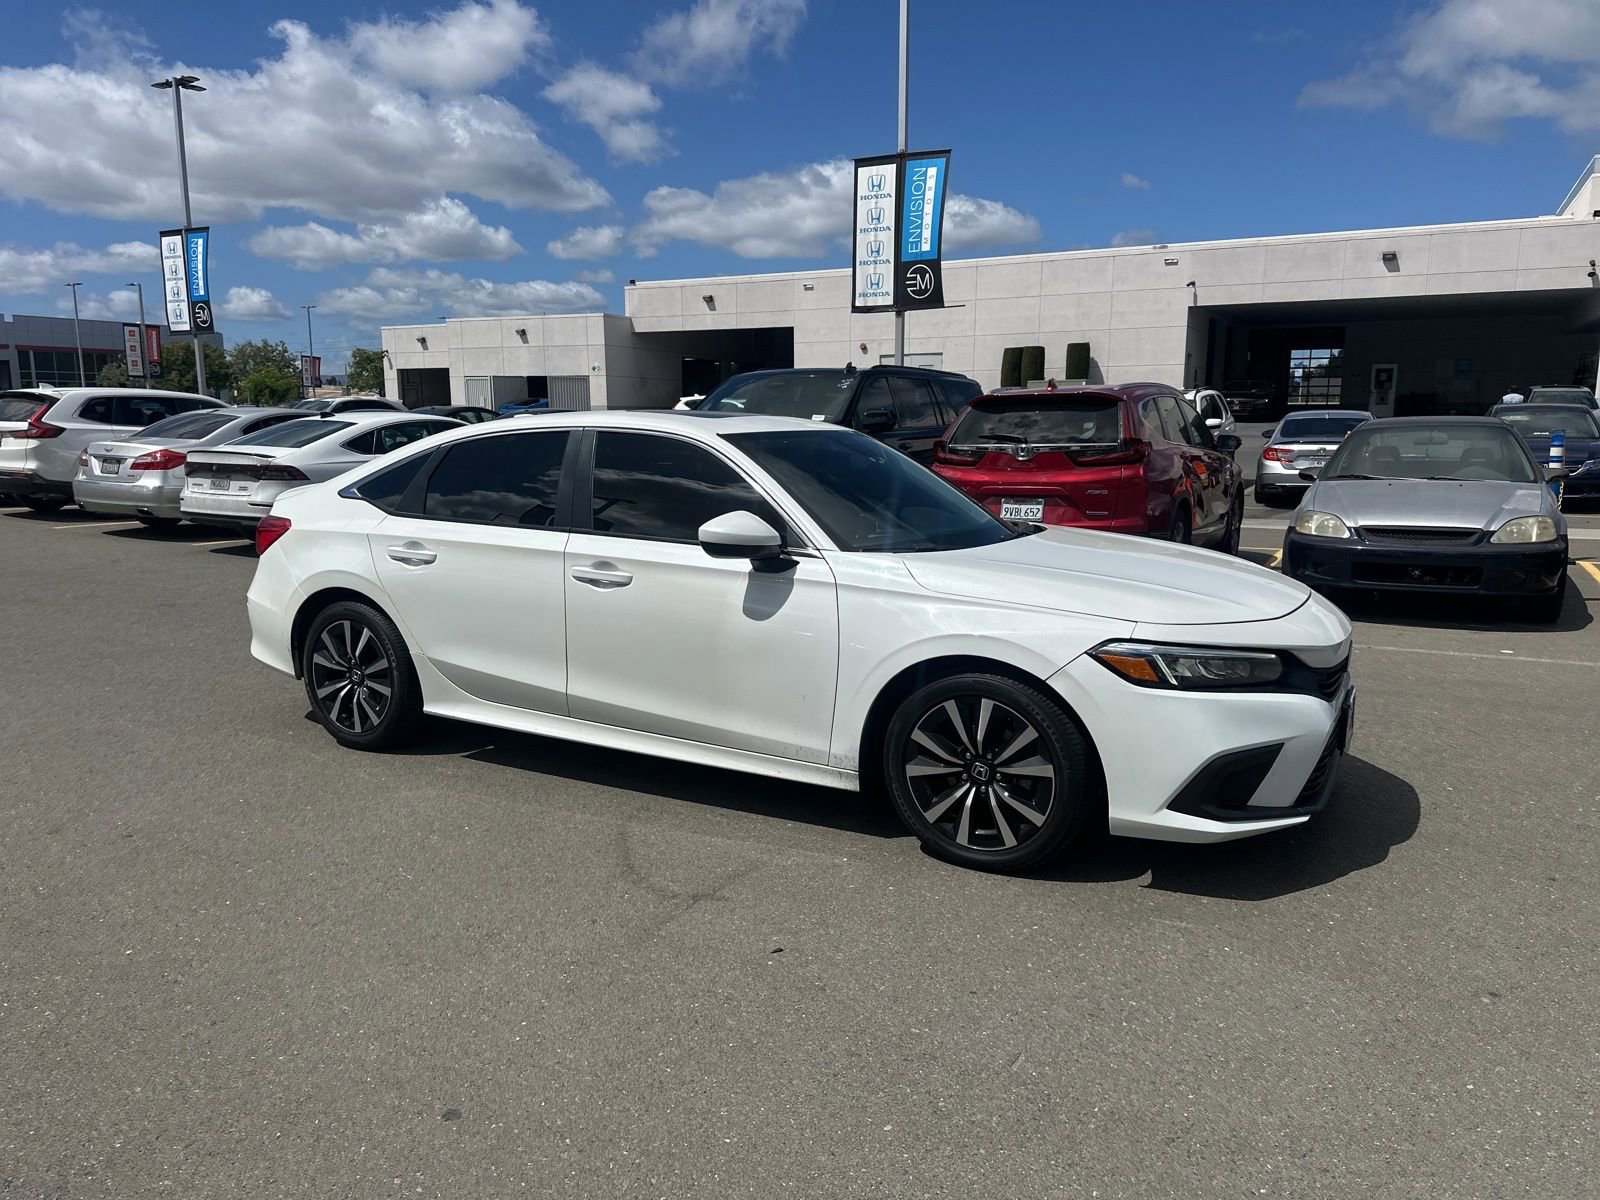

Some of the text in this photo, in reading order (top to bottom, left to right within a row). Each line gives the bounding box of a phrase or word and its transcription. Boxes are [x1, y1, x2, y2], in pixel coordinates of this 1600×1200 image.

[859, 192, 893, 201] HONDA
[908, 167, 927, 253] ENVISION
[923, 174, 935, 245] MOTORS
[859, 225, 892, 234] HONDA
[191, 238, 199, 296] ENVISION
[858, 258, 891, 266] HONDA
[1003, 506, 1041, 518] 9VBL652
